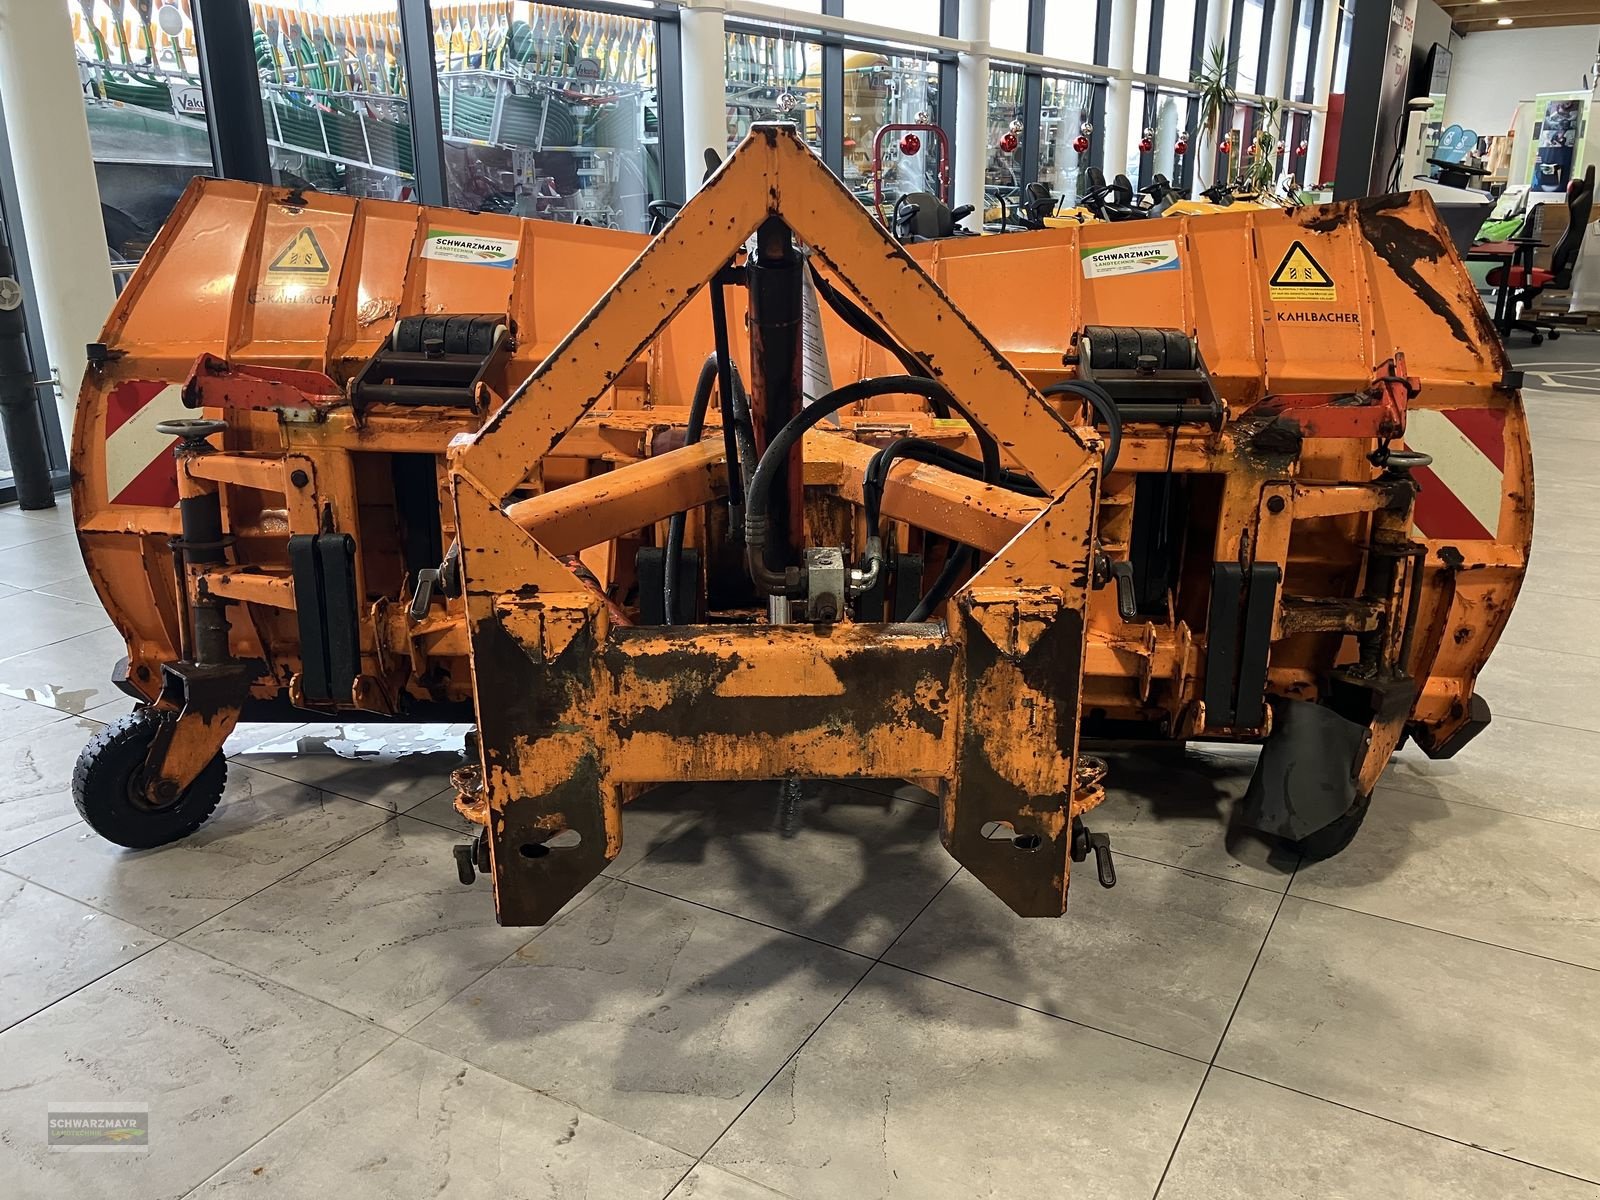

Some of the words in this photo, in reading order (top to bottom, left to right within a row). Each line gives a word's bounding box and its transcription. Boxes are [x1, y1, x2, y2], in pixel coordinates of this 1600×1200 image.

[436, 238, 502, 252] SCHWARZMAYR
[1092, 249, 1161, 262] SCHWARZMAYR
[1277, 312, 1360, 323] KAHLBACHER
